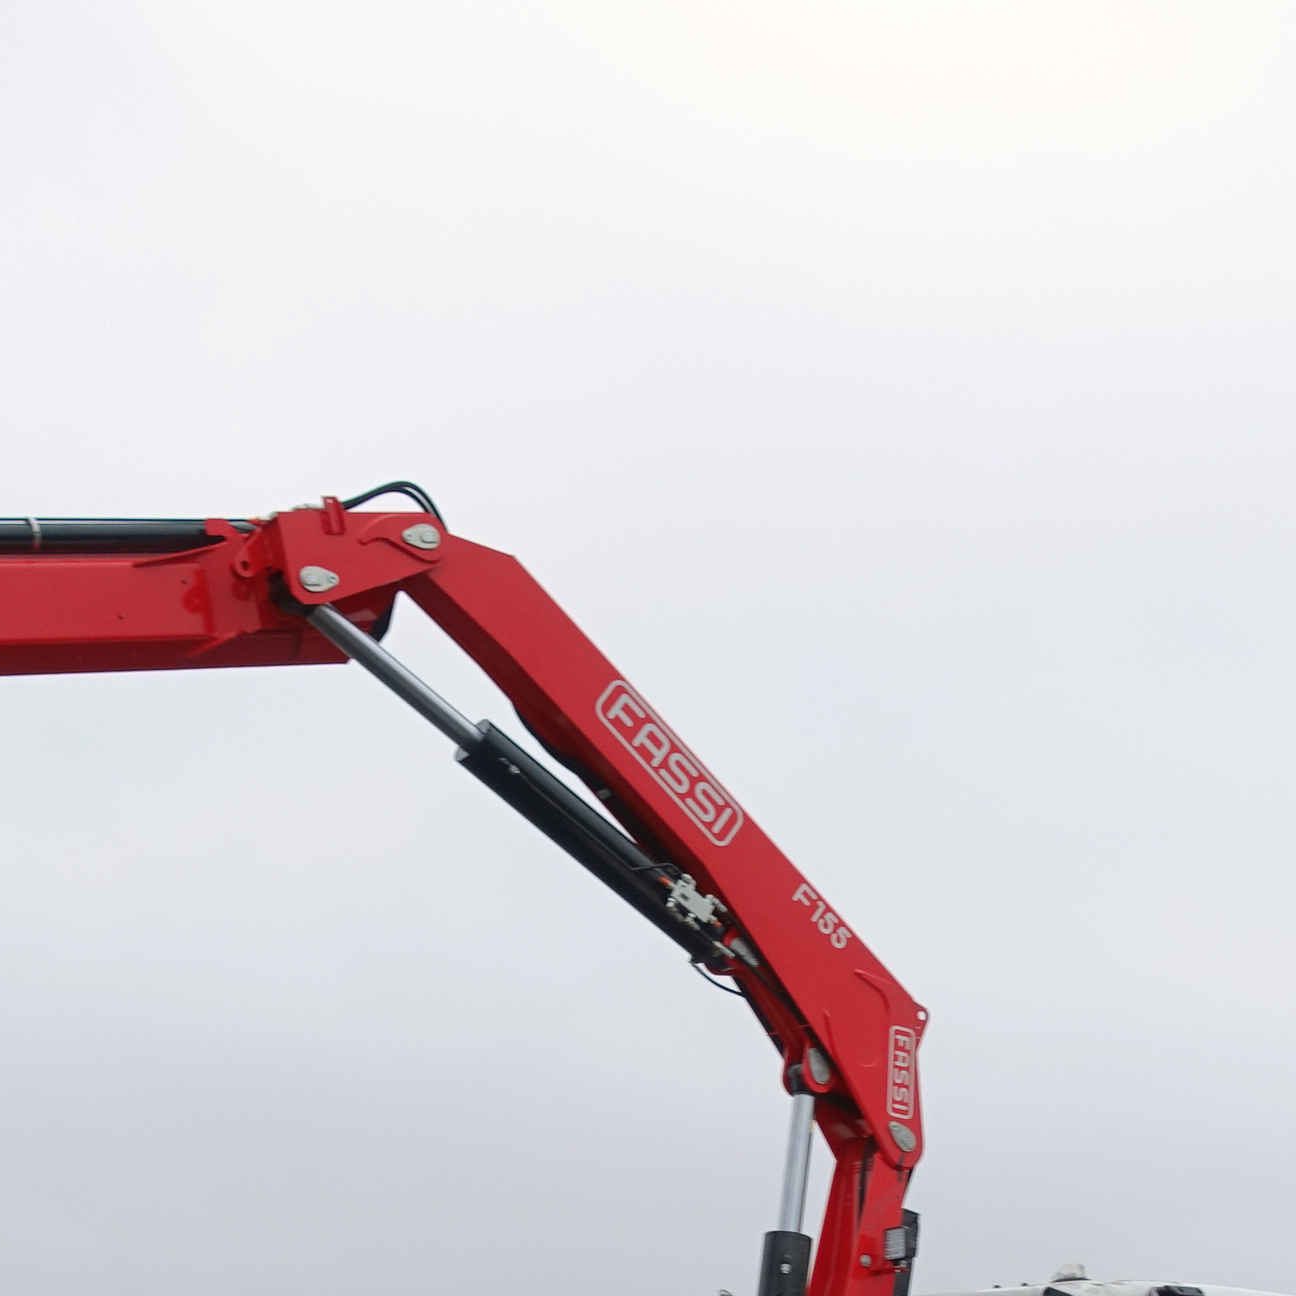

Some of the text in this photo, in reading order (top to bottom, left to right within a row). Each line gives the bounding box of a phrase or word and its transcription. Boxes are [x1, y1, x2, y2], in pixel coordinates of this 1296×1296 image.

[606, 693, 734, 834] FASSI
[792, 883, 852, 949] F155
[892, 1034, 910, 1110] FASSI
